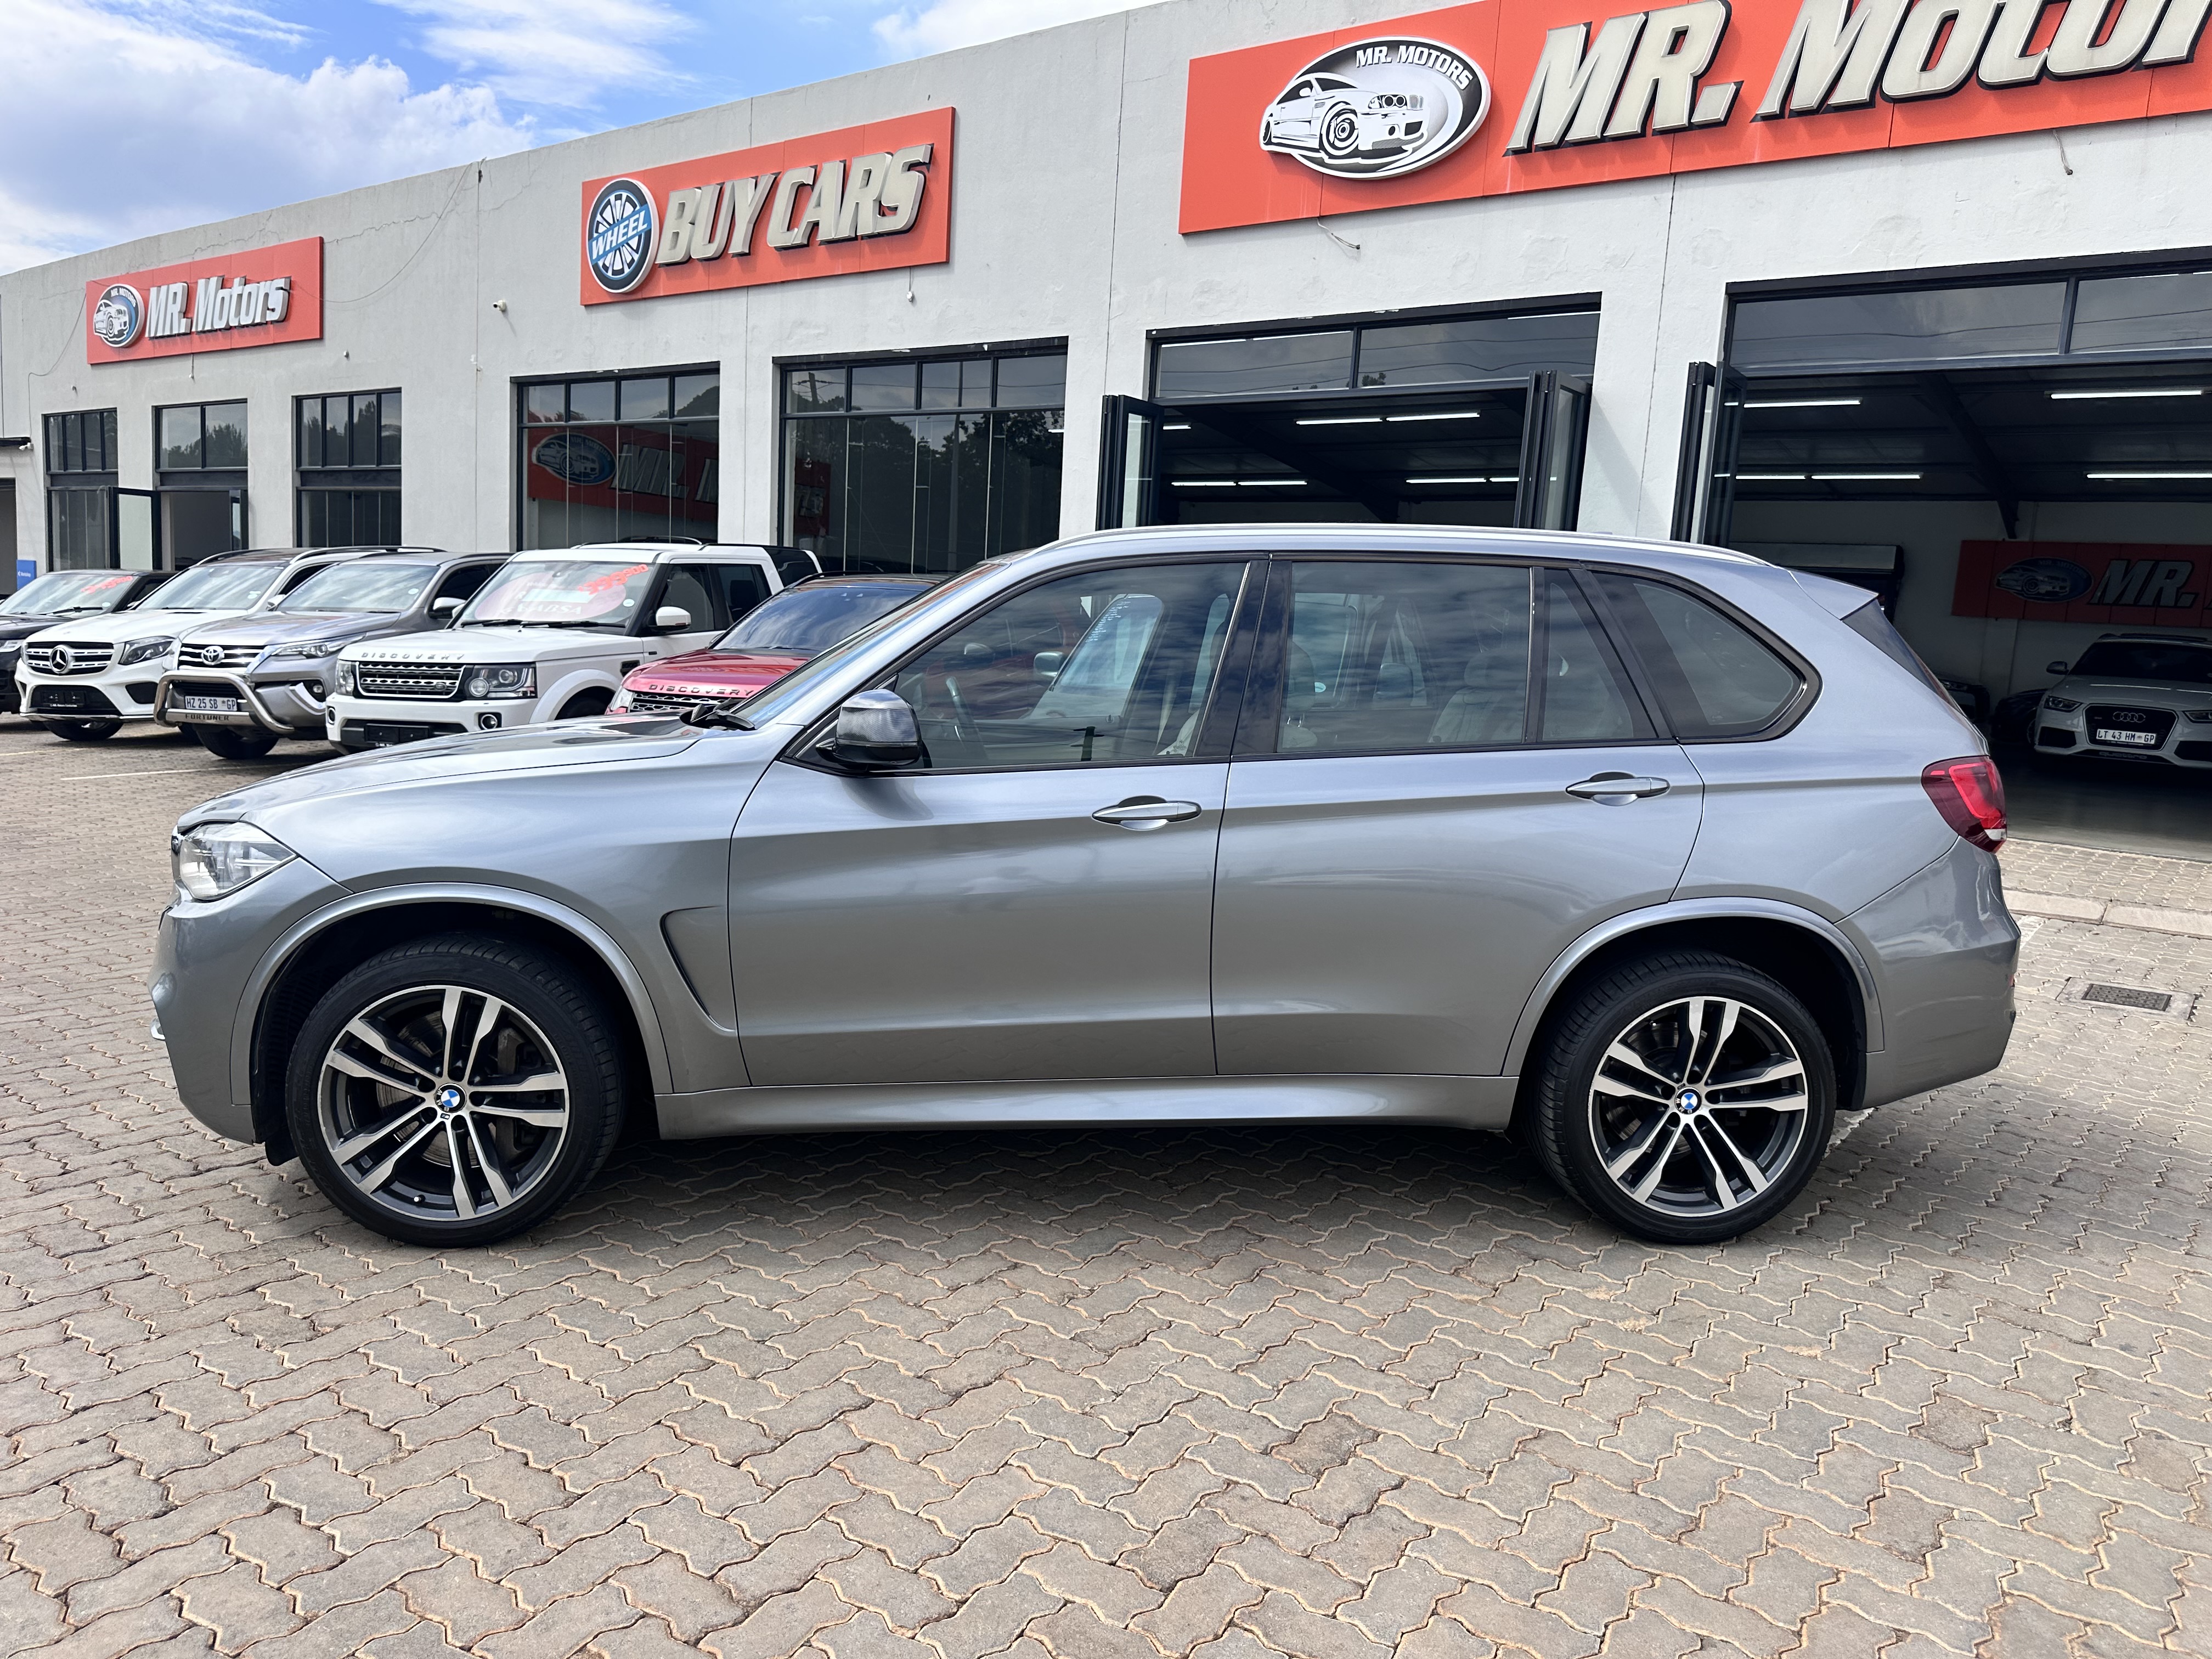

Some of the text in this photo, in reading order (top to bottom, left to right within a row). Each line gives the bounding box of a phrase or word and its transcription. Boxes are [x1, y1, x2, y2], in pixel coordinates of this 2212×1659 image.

[1356, 45, 1473, 91] MR. MOTORS
[1504, 0, 1738, 151] MR.
[655, 144, 932, 264] BUY CARS
[592, 210, 648, 260] WHEEL
[119, 287, 137, 307] MOTORS
[145, 276, 291, 338] MR. Motors
[2091, 560, 2198, 607] MR.
[361, 652, 465, 660] DISCOVERY
[187, 697, 236, 710] HZ 25 SB GP
[648, 684, 754, 696] DISCOVERY
[2097, 730, 2155, 743] LT 43 HM GP
